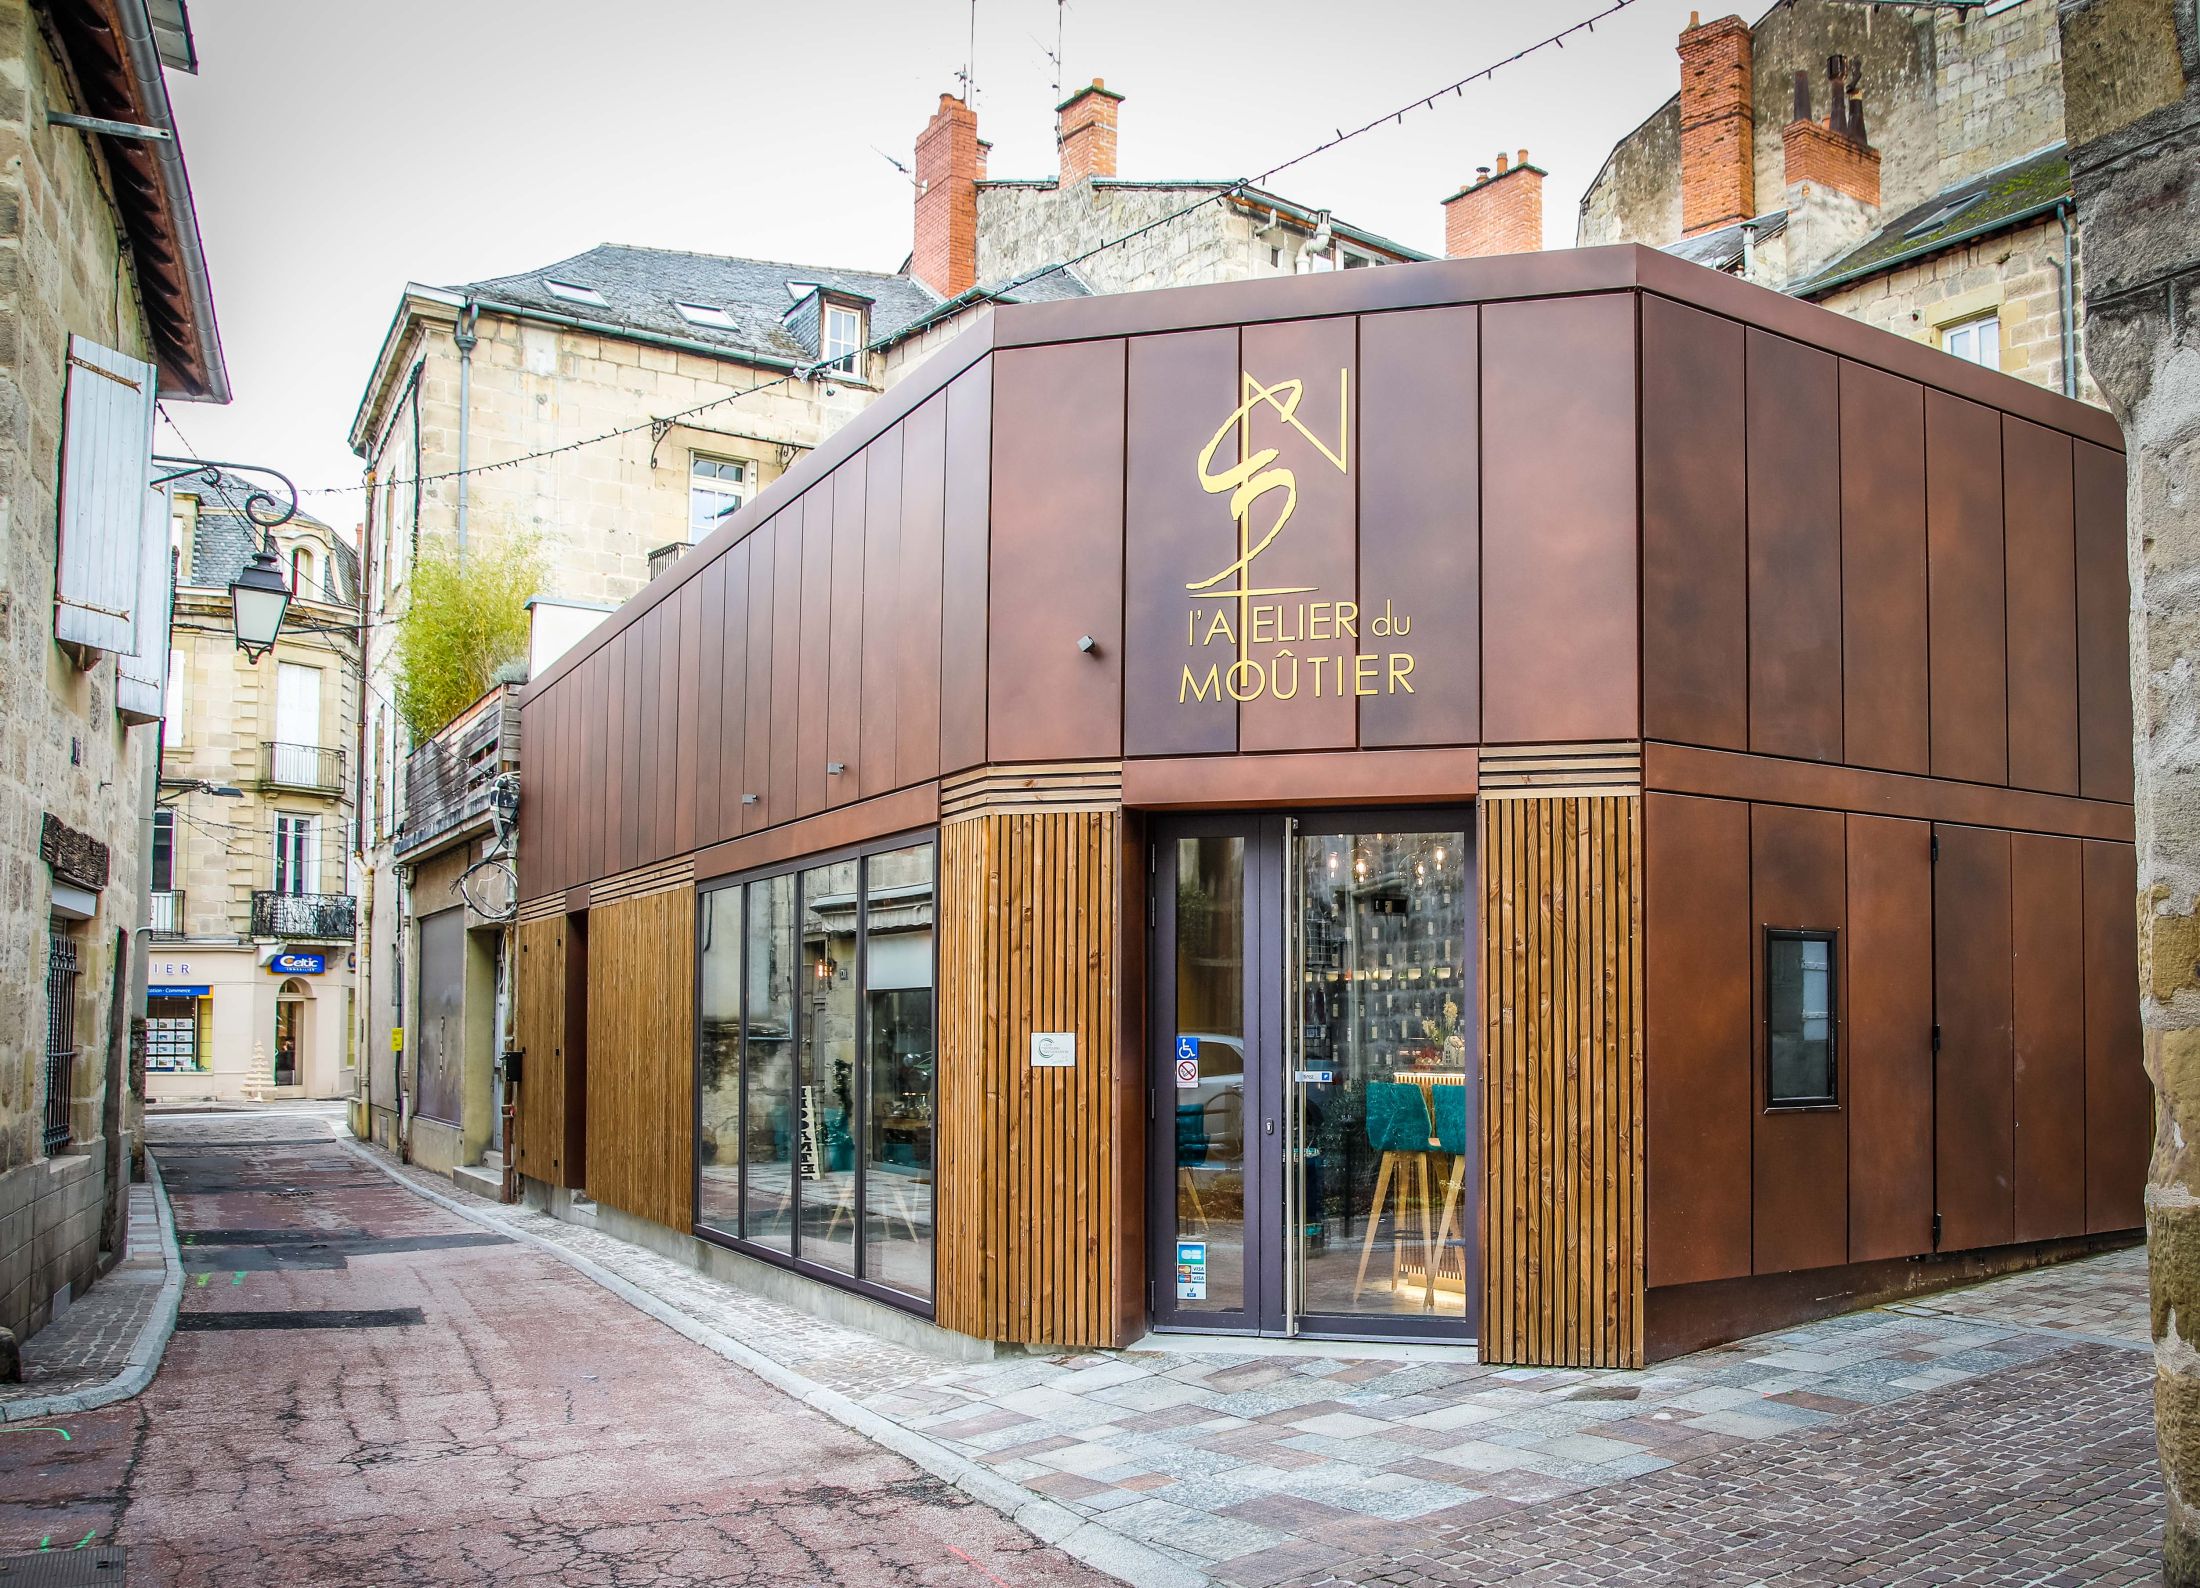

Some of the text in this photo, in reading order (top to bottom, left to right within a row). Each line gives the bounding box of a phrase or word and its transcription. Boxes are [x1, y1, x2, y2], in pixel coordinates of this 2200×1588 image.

[1371, 599, 1412, 637] du
[1179, 649, 1416, 703] MOÛTIER
[280, 955, 319, 967] Celtic
